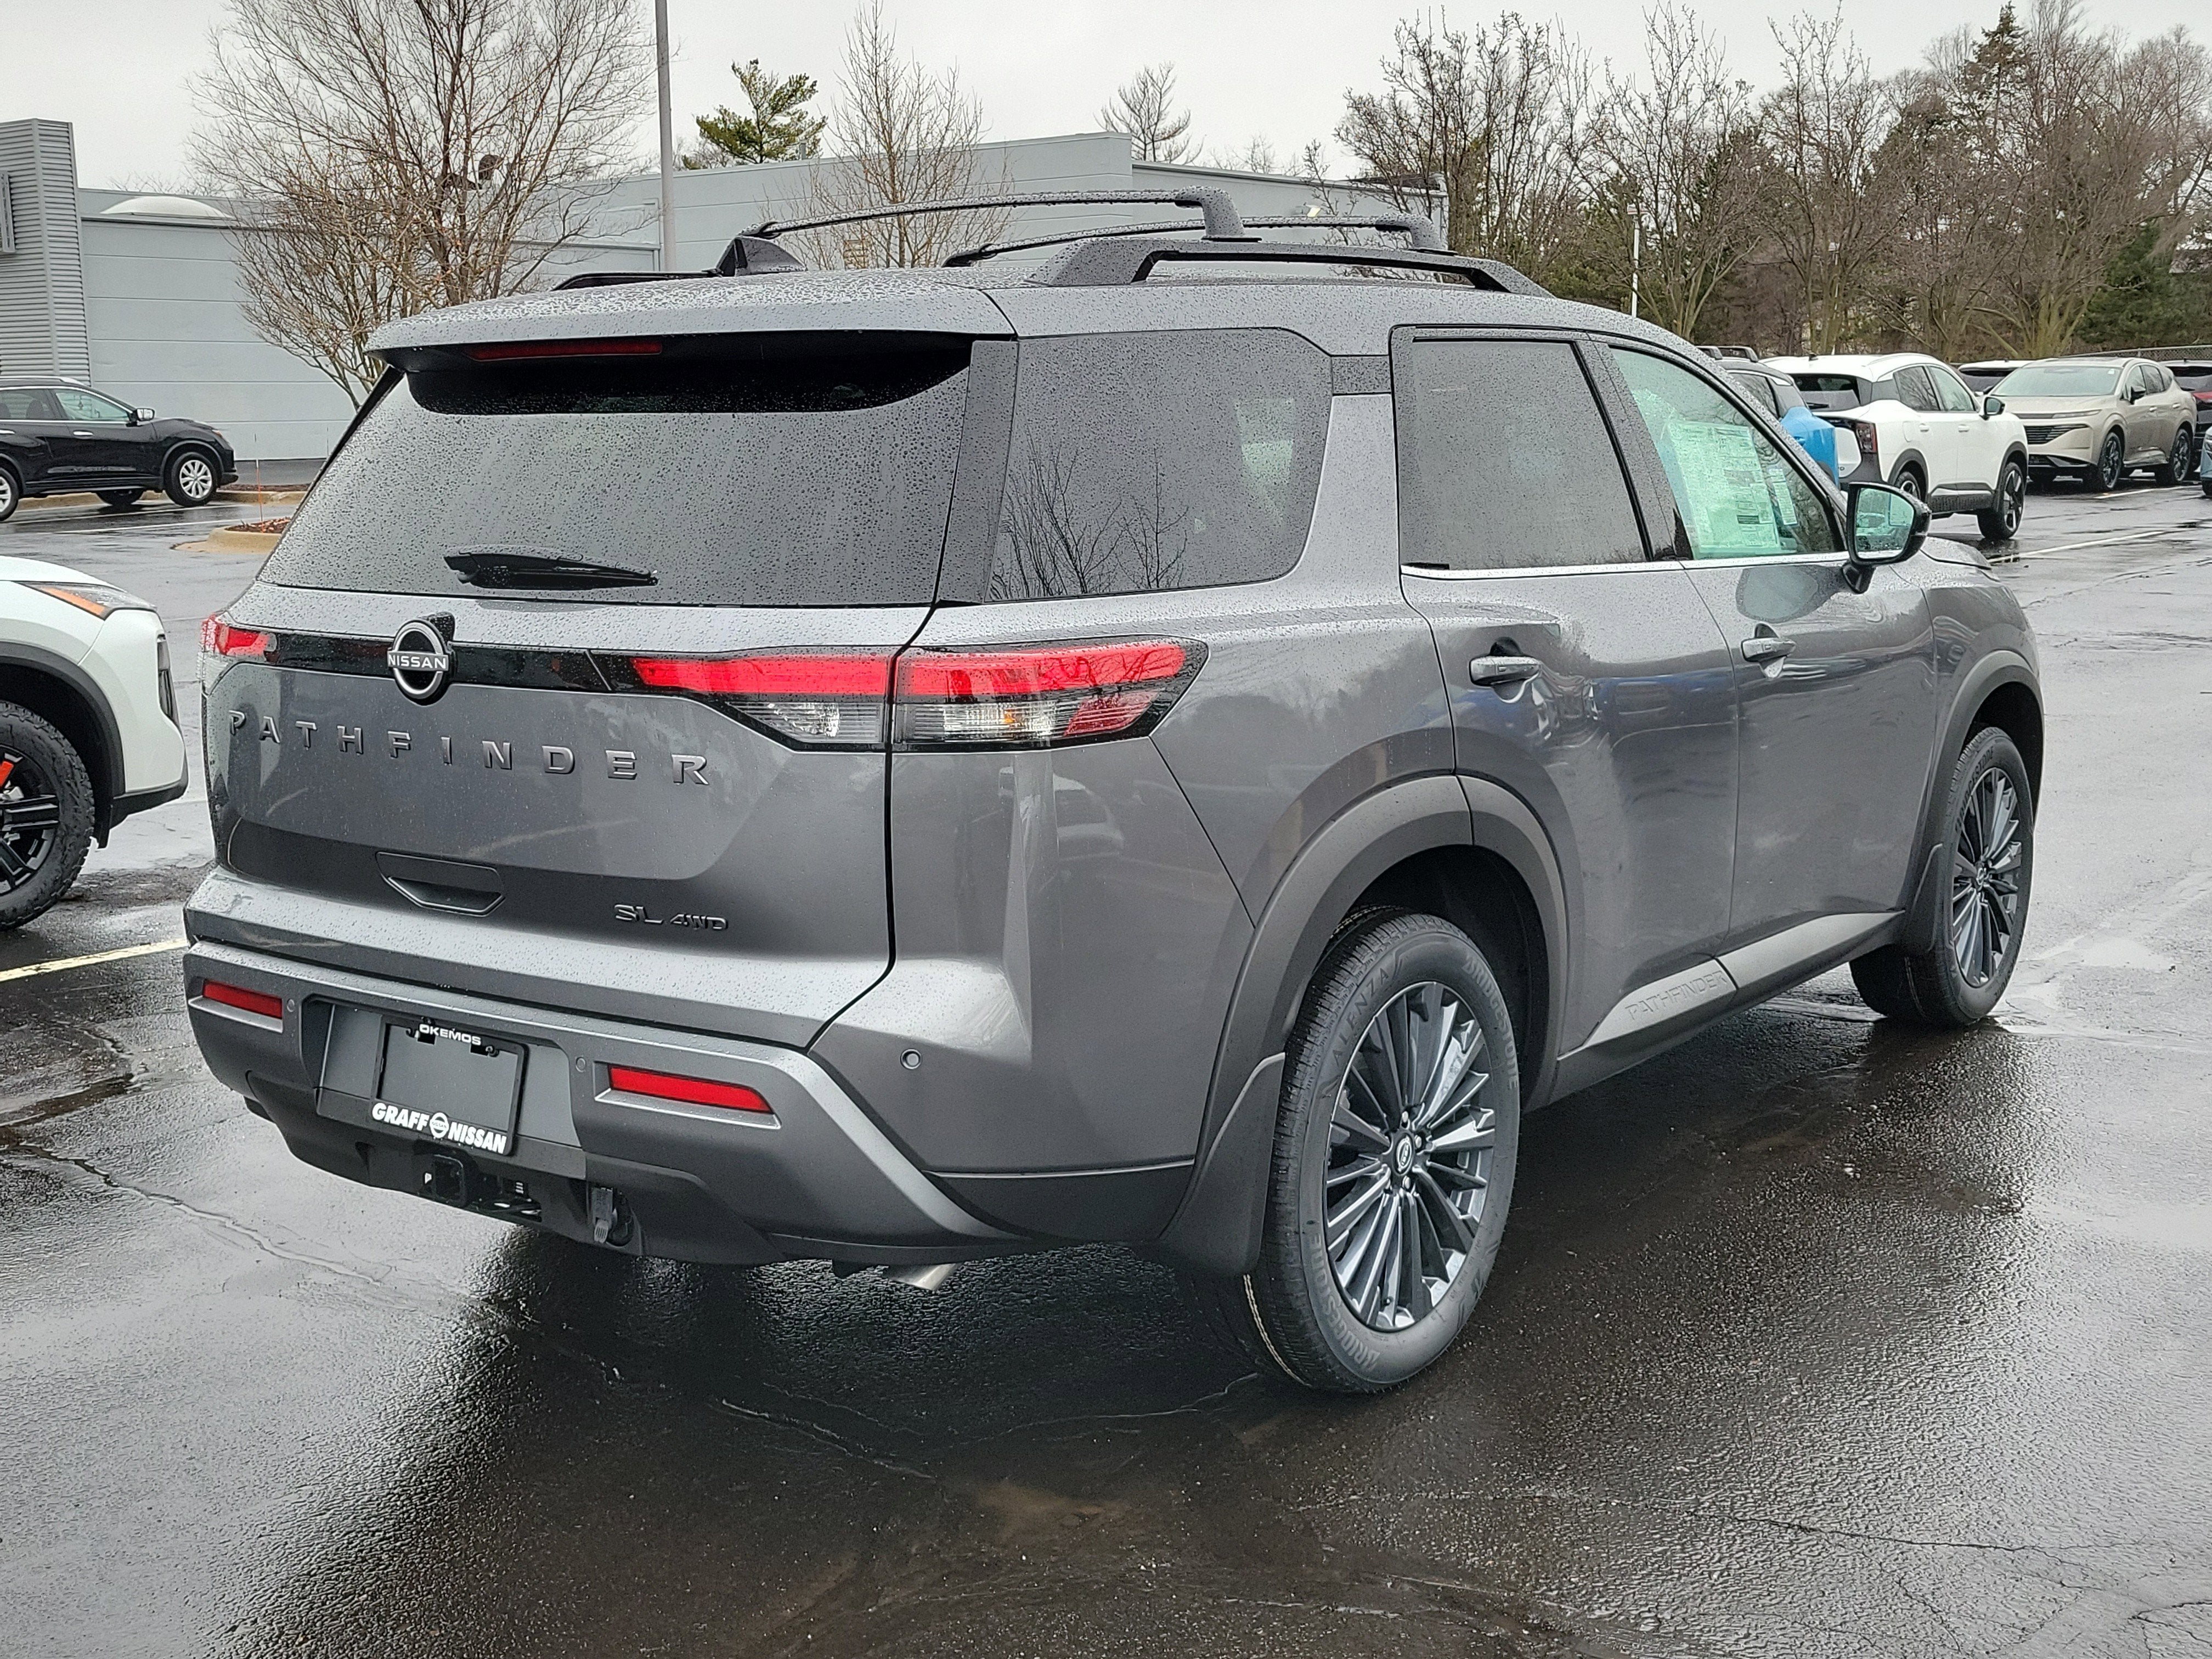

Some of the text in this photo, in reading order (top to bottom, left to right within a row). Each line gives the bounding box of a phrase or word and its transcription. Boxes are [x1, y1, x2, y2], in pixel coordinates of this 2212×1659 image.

[388, 654, 446, 669] NISSAN
[228, 709, 709, 786] PATHFINDER
[614, 904, 729, 930] SL 4WD
[1332, 967, 1389, 1066] ALENZA
[1625, 970, 1728, 1020] PATHFINDER
[419, 1024, 482, 1046] OKEMOS
[372, 1103, 430, 1131] GRAFF
[448, 1122, 507, 1154] NISSAN
[1308, 1233, 1381, 1371] BRIDGESTONE
